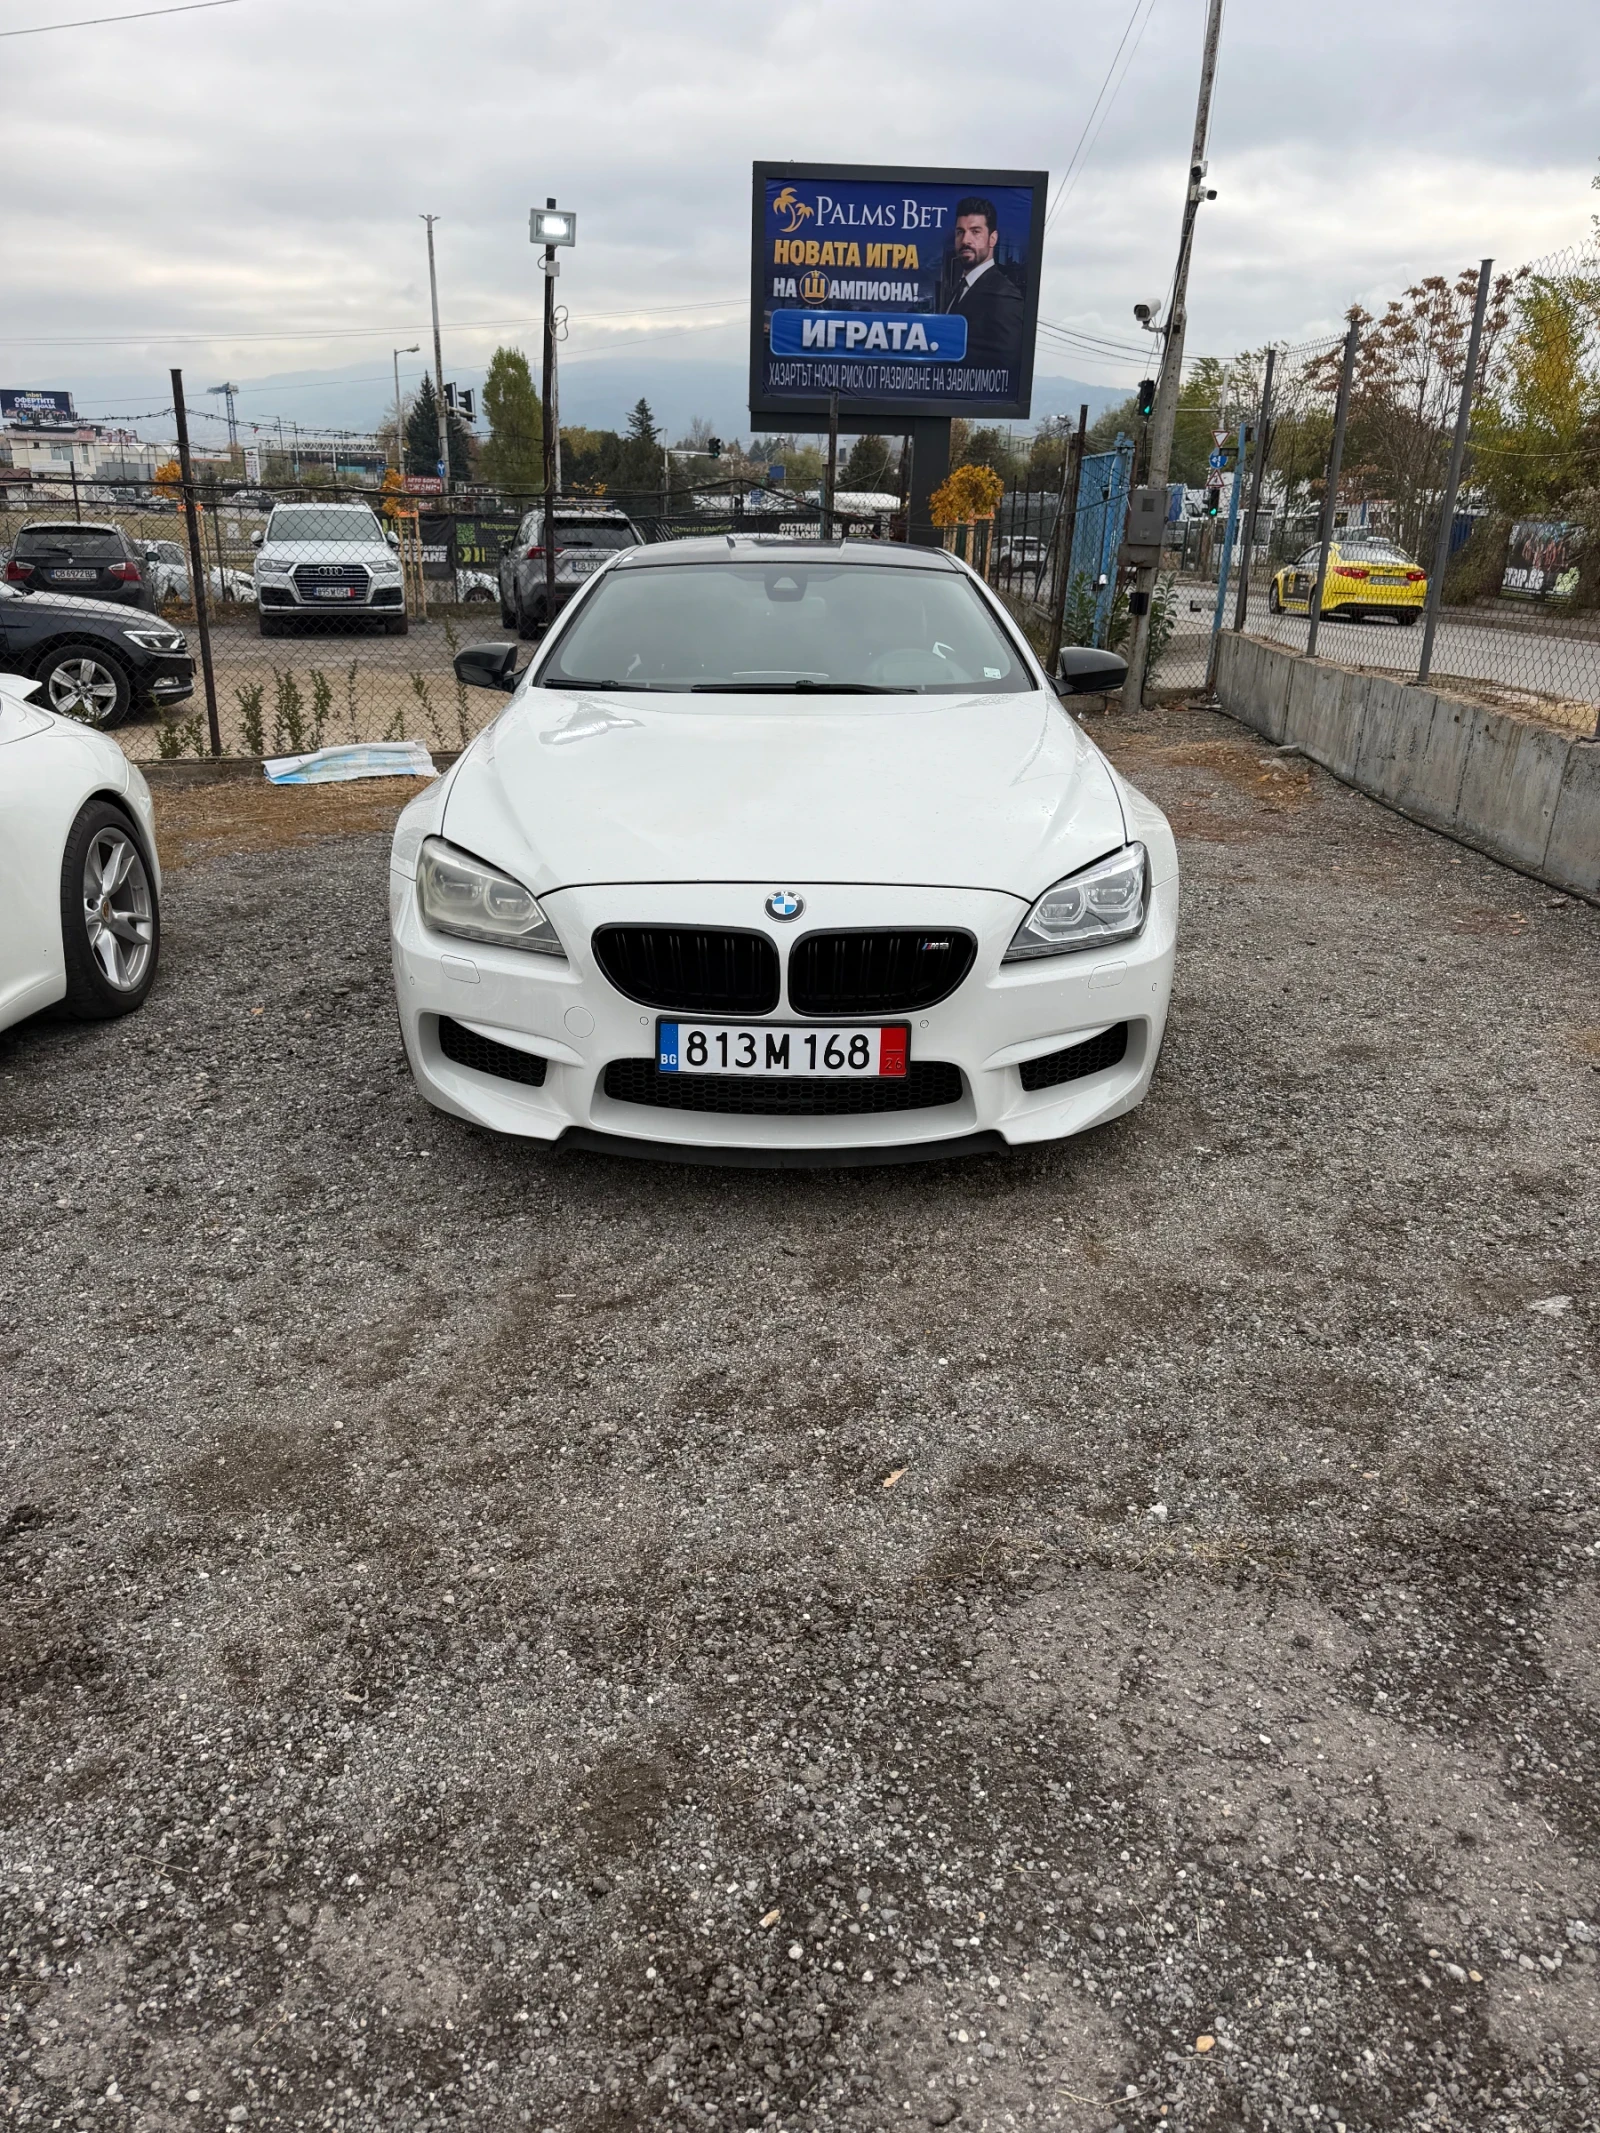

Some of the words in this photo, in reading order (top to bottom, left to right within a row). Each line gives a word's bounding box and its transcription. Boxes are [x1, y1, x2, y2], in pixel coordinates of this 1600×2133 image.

[773, 239, 861, 268] НОВАТА
[866, 242, 919, 270] ИГРА
[773, 277, 797, 298] НА
[802, 319, 940, 352] ИГРАТА.
[769, 362, 813, 387] ХАЗАРТЪТ
[814, 364, 840, 388] НОСИ
[840, 365, 864, 389] РИСК
[866, 366, 879, 389] ОТ
[879, 366, 931, 391] РАЗВИВАНЕ
[932, 368, 945, 391] НА
[946, 368, 1009, 393] ЗАВИСИМОСТ!
[660, 1053, 677, 1065] BG
[885, 1057, 903, 1070] 26
